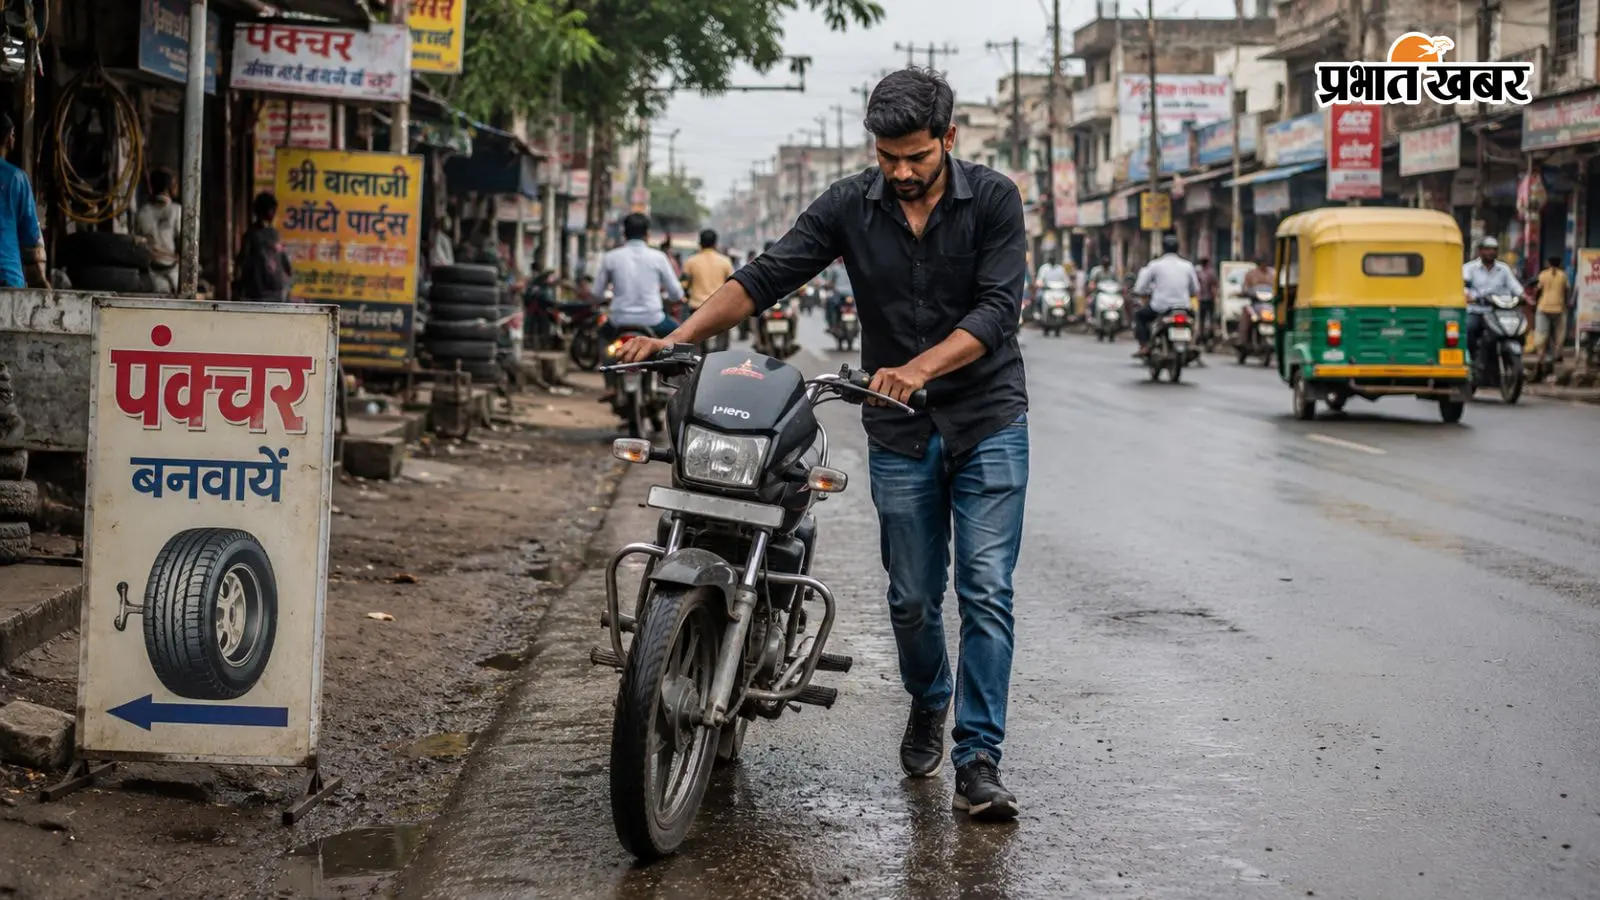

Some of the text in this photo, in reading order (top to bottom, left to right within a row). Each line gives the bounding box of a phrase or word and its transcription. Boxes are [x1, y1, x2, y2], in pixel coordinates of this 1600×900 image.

[287, 159, 317, 193] श्री
[110, 324, 314, 432] पंक्चर
[130, 446, 290, 502] बनवायें
